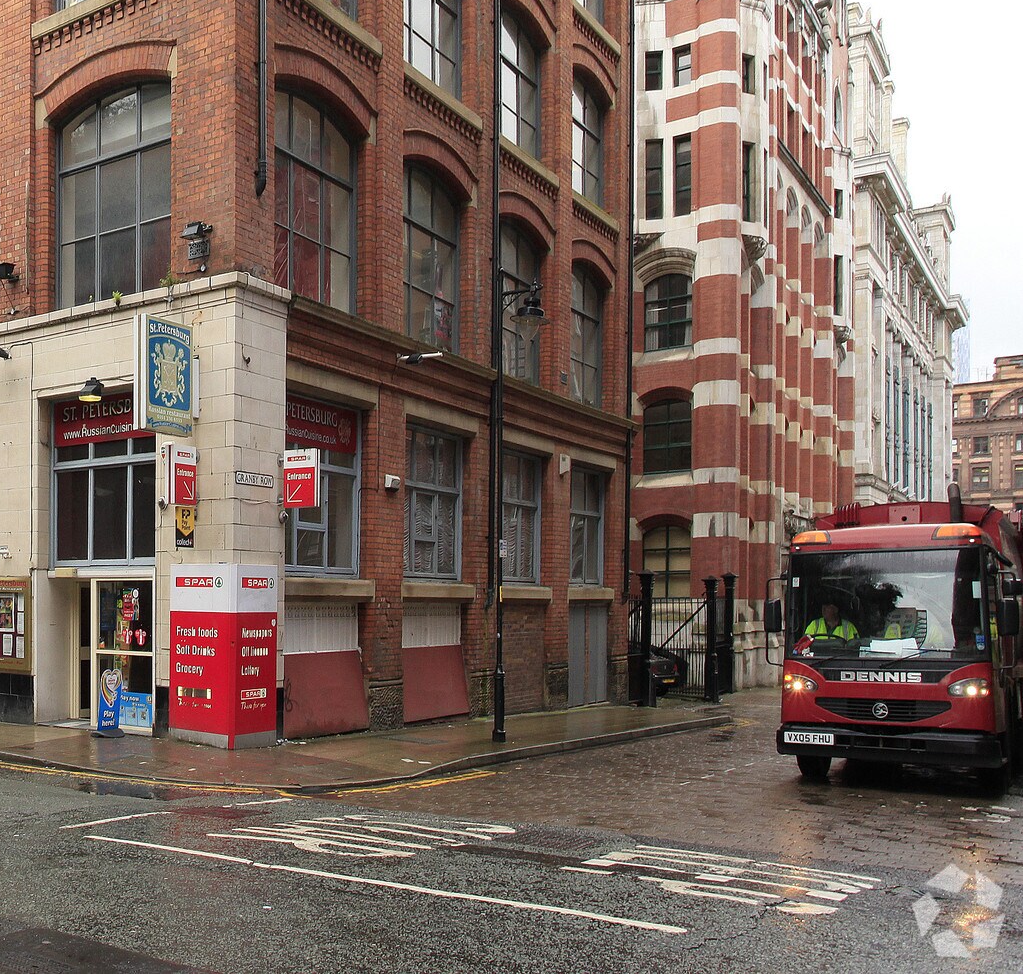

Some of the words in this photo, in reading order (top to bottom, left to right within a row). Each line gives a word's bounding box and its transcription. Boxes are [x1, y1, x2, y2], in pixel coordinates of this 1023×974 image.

[63, 406, 77, 421] ST.
[286, 402, 337, 427] PETERSBURG
[177, 468, 194, 477] Entrance
[286, 472, 312, 481] Entrance
[237, 473, 259, 484] GRANBY
[184, 578, 213, 586] SPAR
[247, 579, 268, 587] SPAR
[176, 626, 196, 637] Fresh
[198, 626, 218, 638] foods
[176, 644, 190, 655] Soft
[192, 645, 216, 657] Drinks
[176, 662, 204, 677] Grocery
[840, 671, 922, 683] DENNIS
[245, 690, 260, 698] SPAR
[104, 710, 115, 718] Play
[786, 733, 810, 743] VX05
[812, 734, 831, 744] FHU
